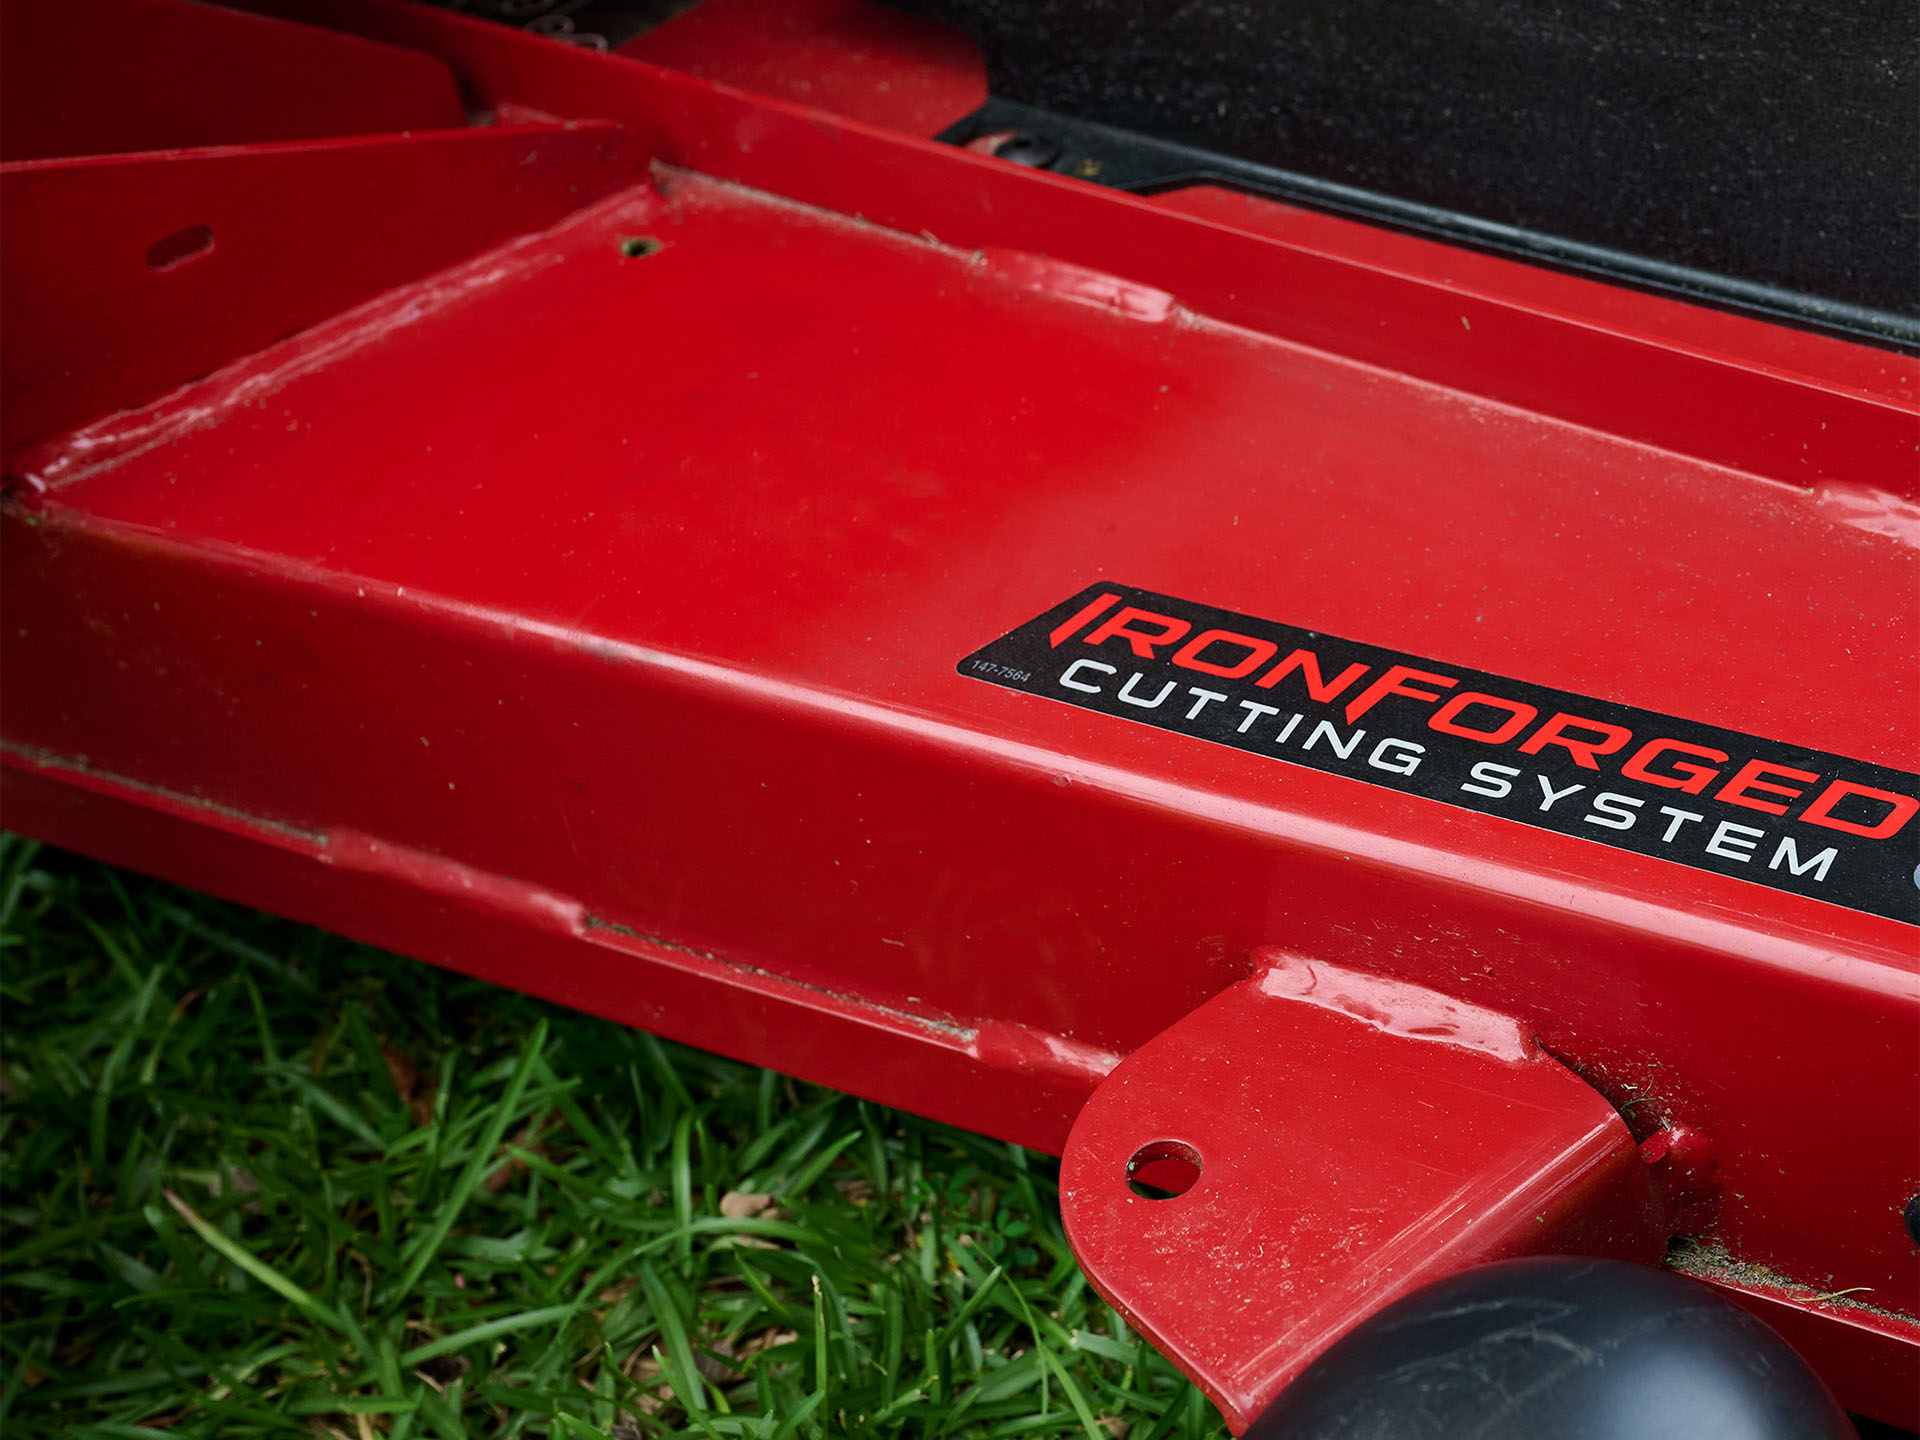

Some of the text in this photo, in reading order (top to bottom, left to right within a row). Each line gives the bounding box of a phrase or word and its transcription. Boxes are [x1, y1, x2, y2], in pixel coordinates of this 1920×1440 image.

[972, 660, 1031, 682] 147-7564
[1049, 592, 1920, 840] IRONFORGED
[1059, 658, 1839, 882] CUTTING SYSTEM
